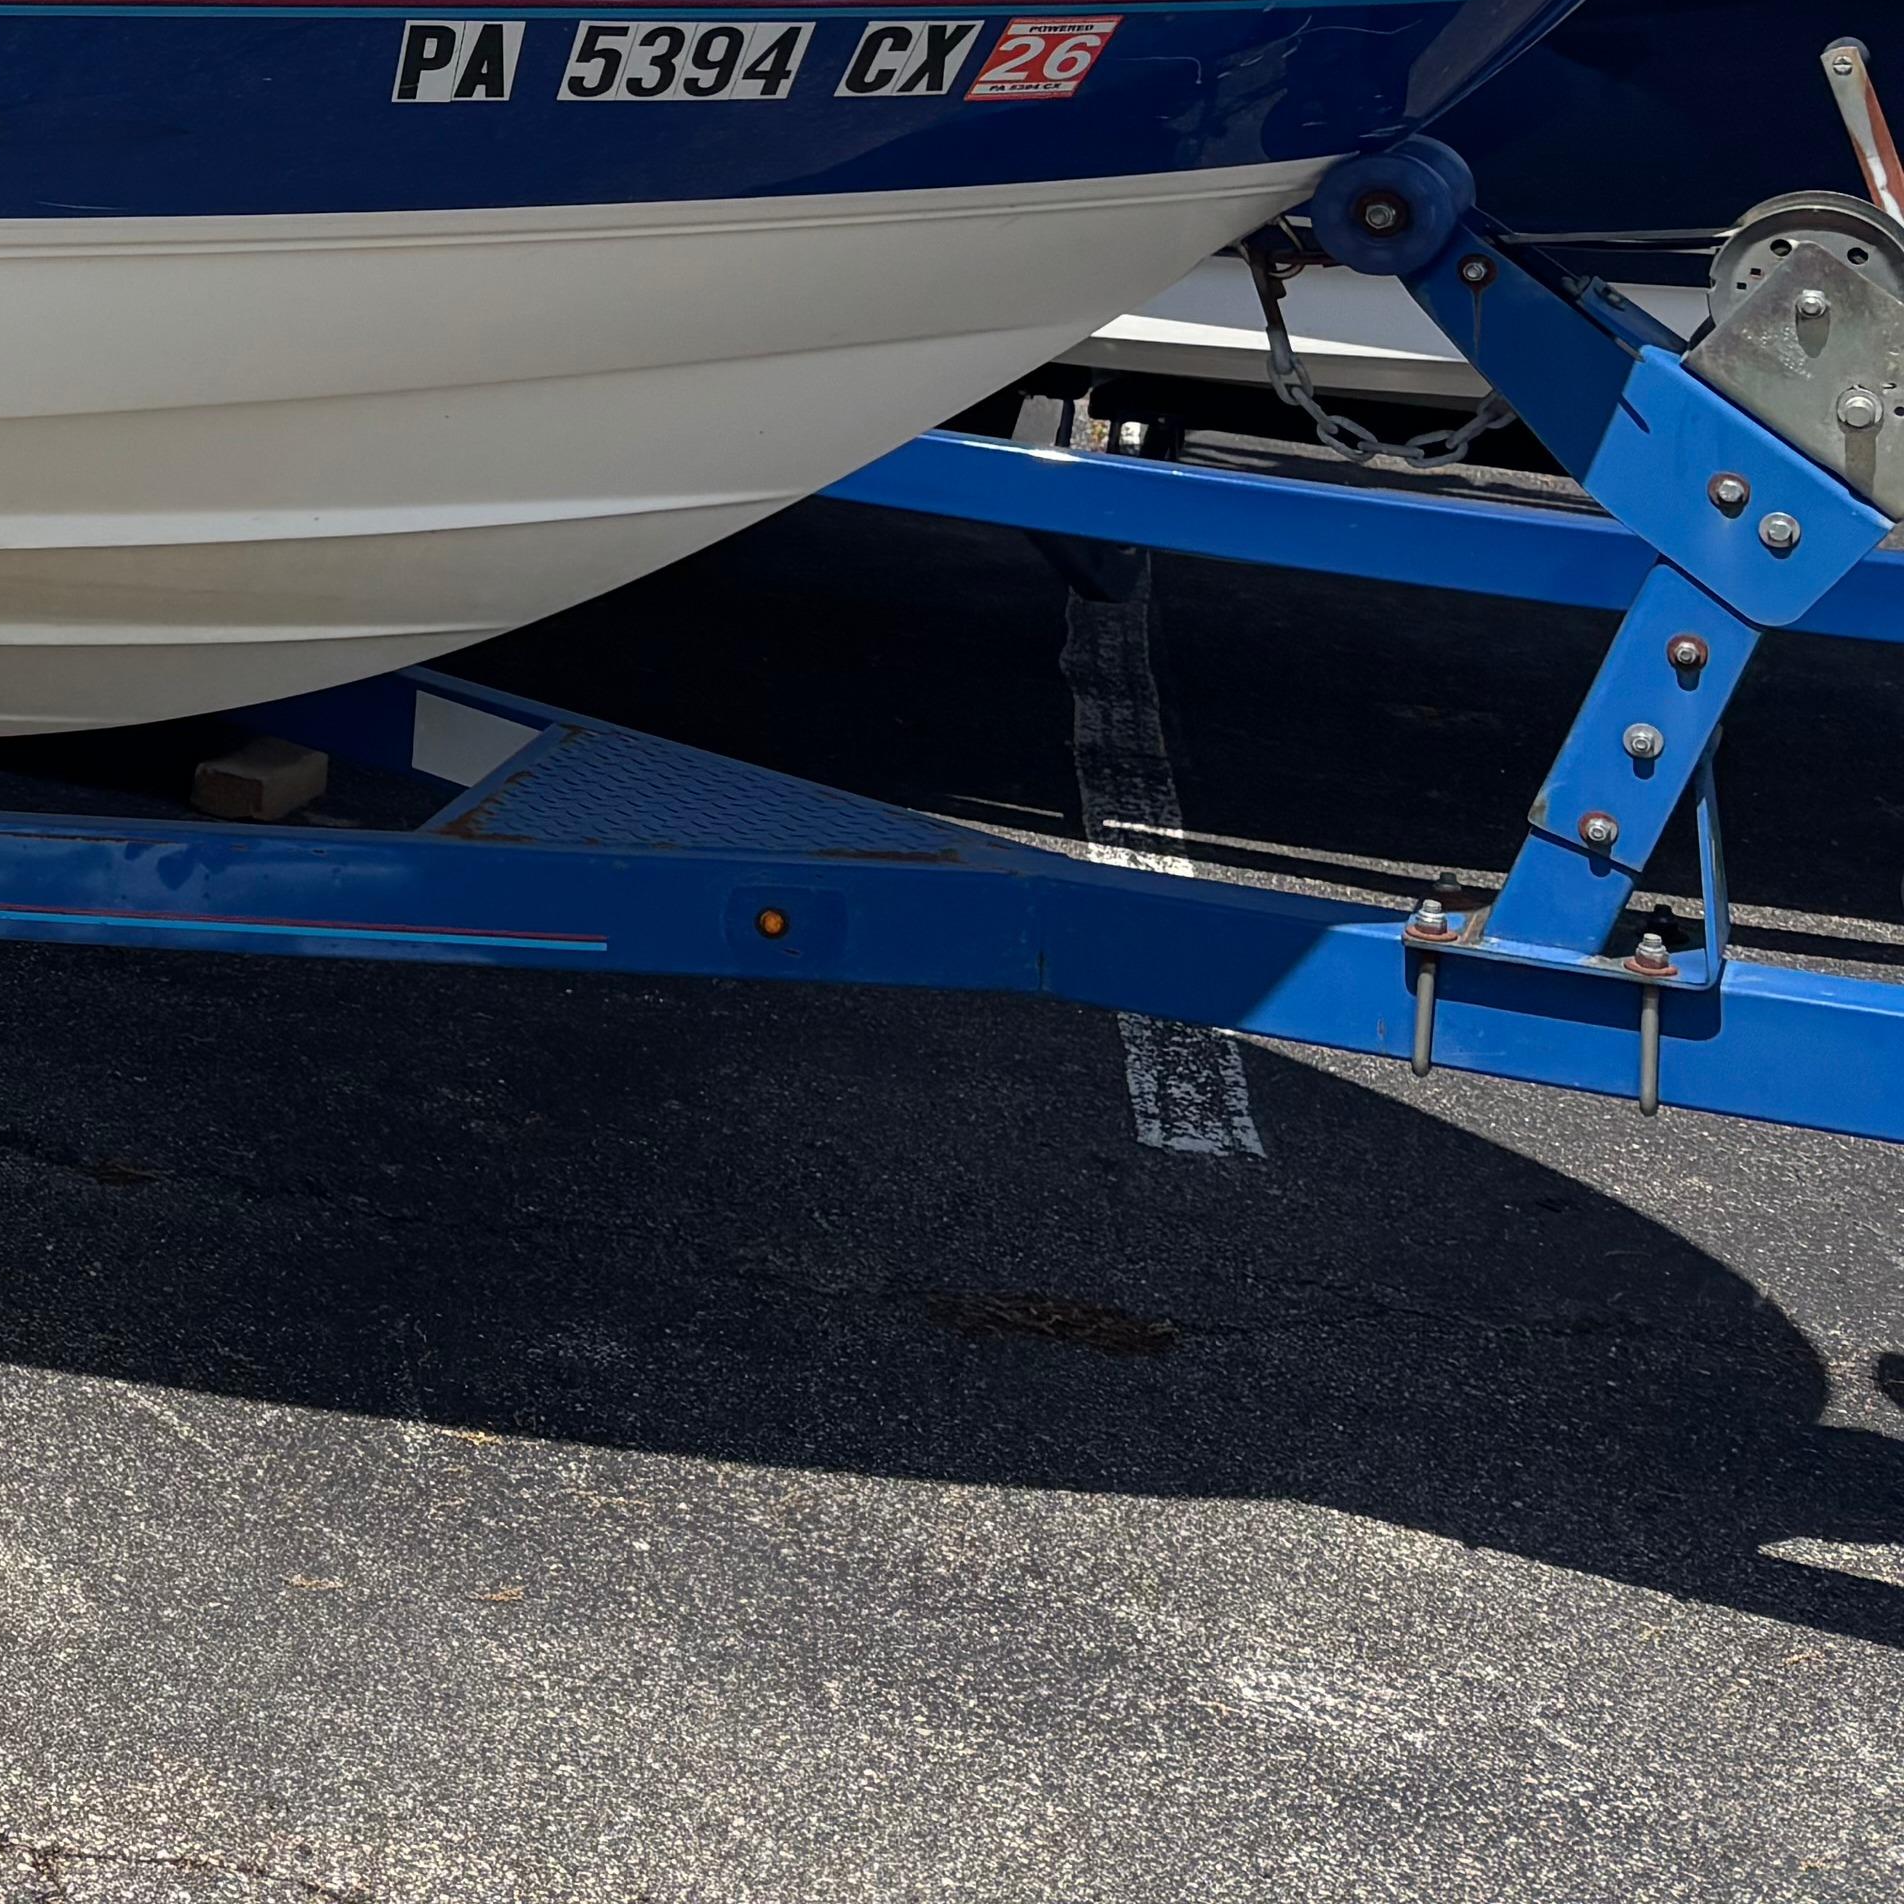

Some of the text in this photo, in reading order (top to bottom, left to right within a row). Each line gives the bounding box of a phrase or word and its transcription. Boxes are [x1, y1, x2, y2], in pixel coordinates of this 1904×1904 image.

[396, 22, 978, 100] PA 5394 CX
[978, 33, 1102, 82] 26
